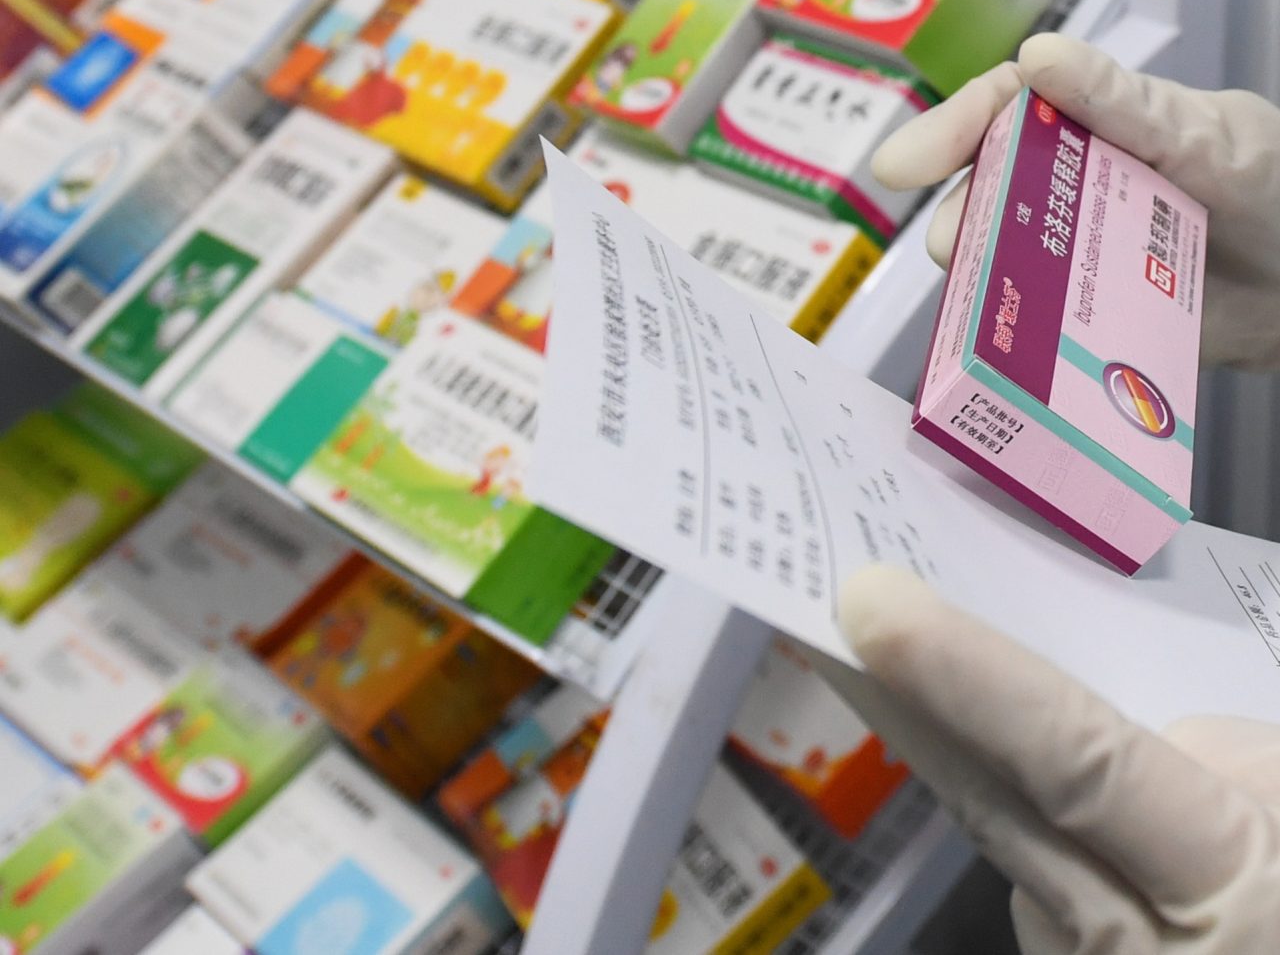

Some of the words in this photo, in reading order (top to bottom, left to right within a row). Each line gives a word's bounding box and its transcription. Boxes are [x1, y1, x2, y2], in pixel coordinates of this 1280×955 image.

[1040, 126, 1086, 258] 布洛芬缓释胶囊
[1072, 269, 1100, 328] Ibuprofen
[959, 404, 1014, 445] 【生产日期】
[969, 391, 1025, 433] 【产品批号】
[949, 415, 1005, 455] 【有效期至】
